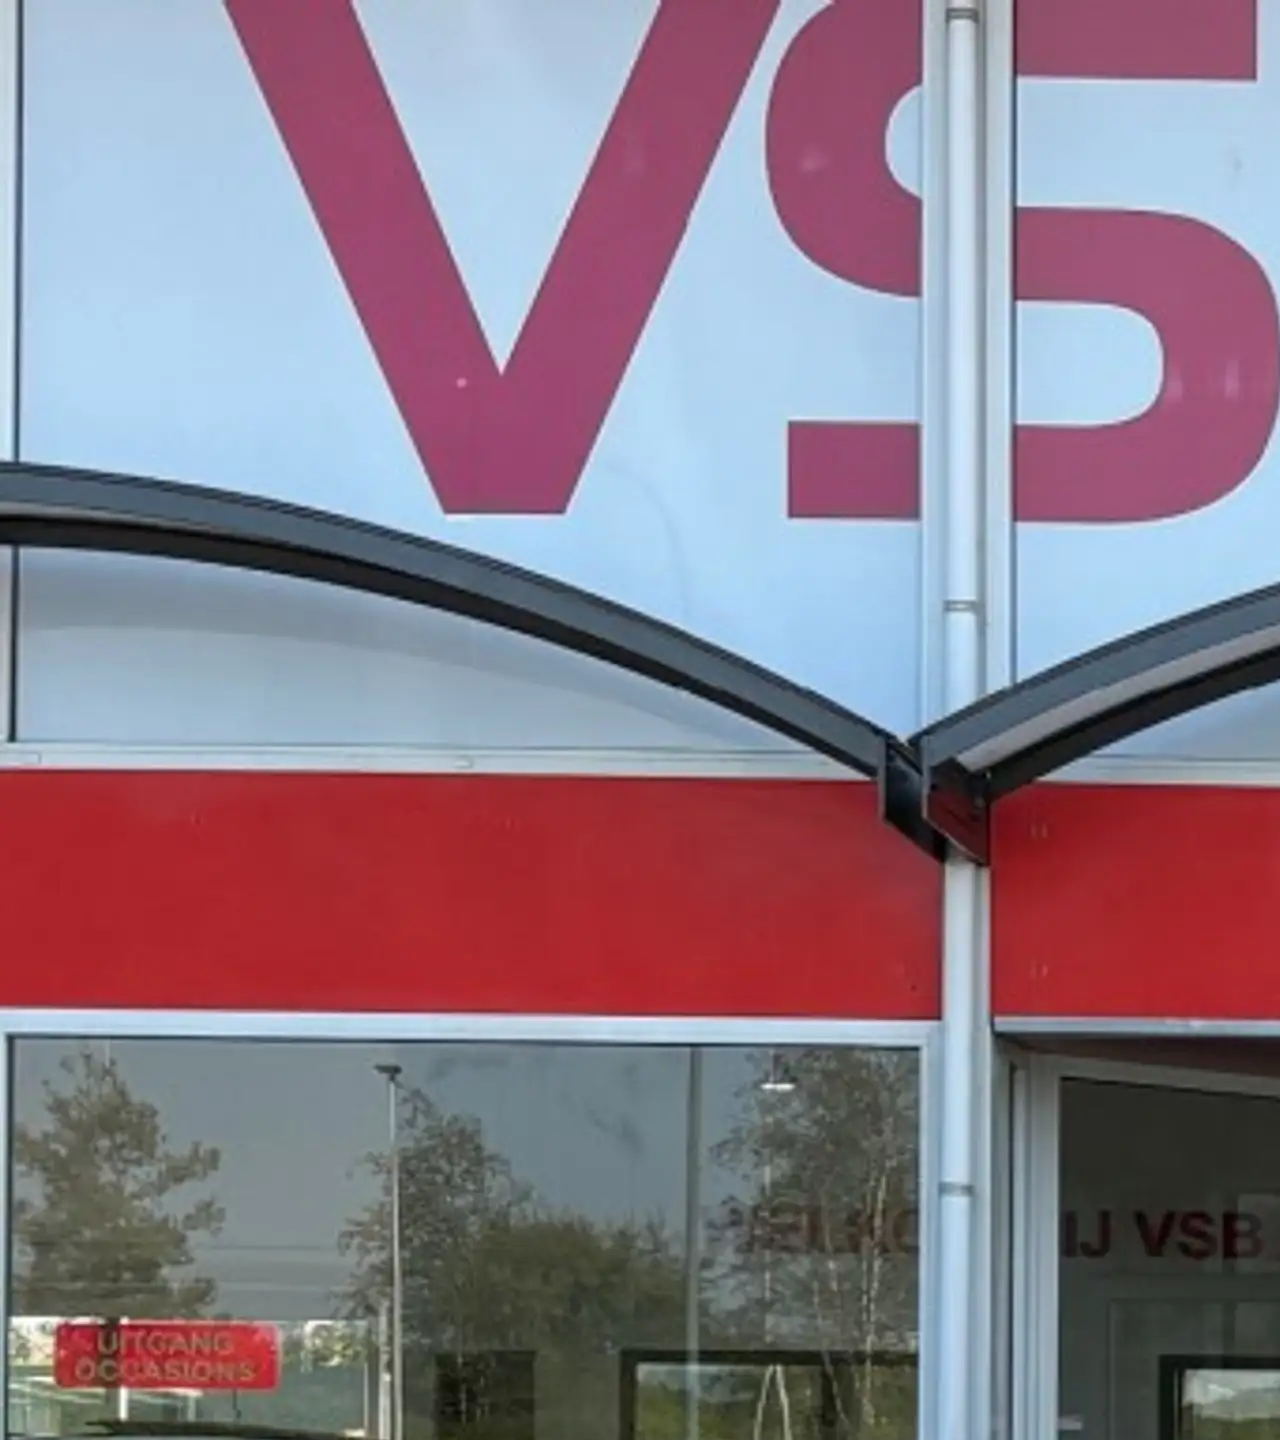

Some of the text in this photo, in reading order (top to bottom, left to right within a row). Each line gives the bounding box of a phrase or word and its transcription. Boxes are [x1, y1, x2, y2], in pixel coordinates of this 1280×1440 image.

[1062, 1210, 1110, 1259] IJ
[1133, 1210, 1264, 1260] VSB
[98, 1330, 234, 1354] UITGANG
[75, 1357, 256, 1382] OCCASIONS
